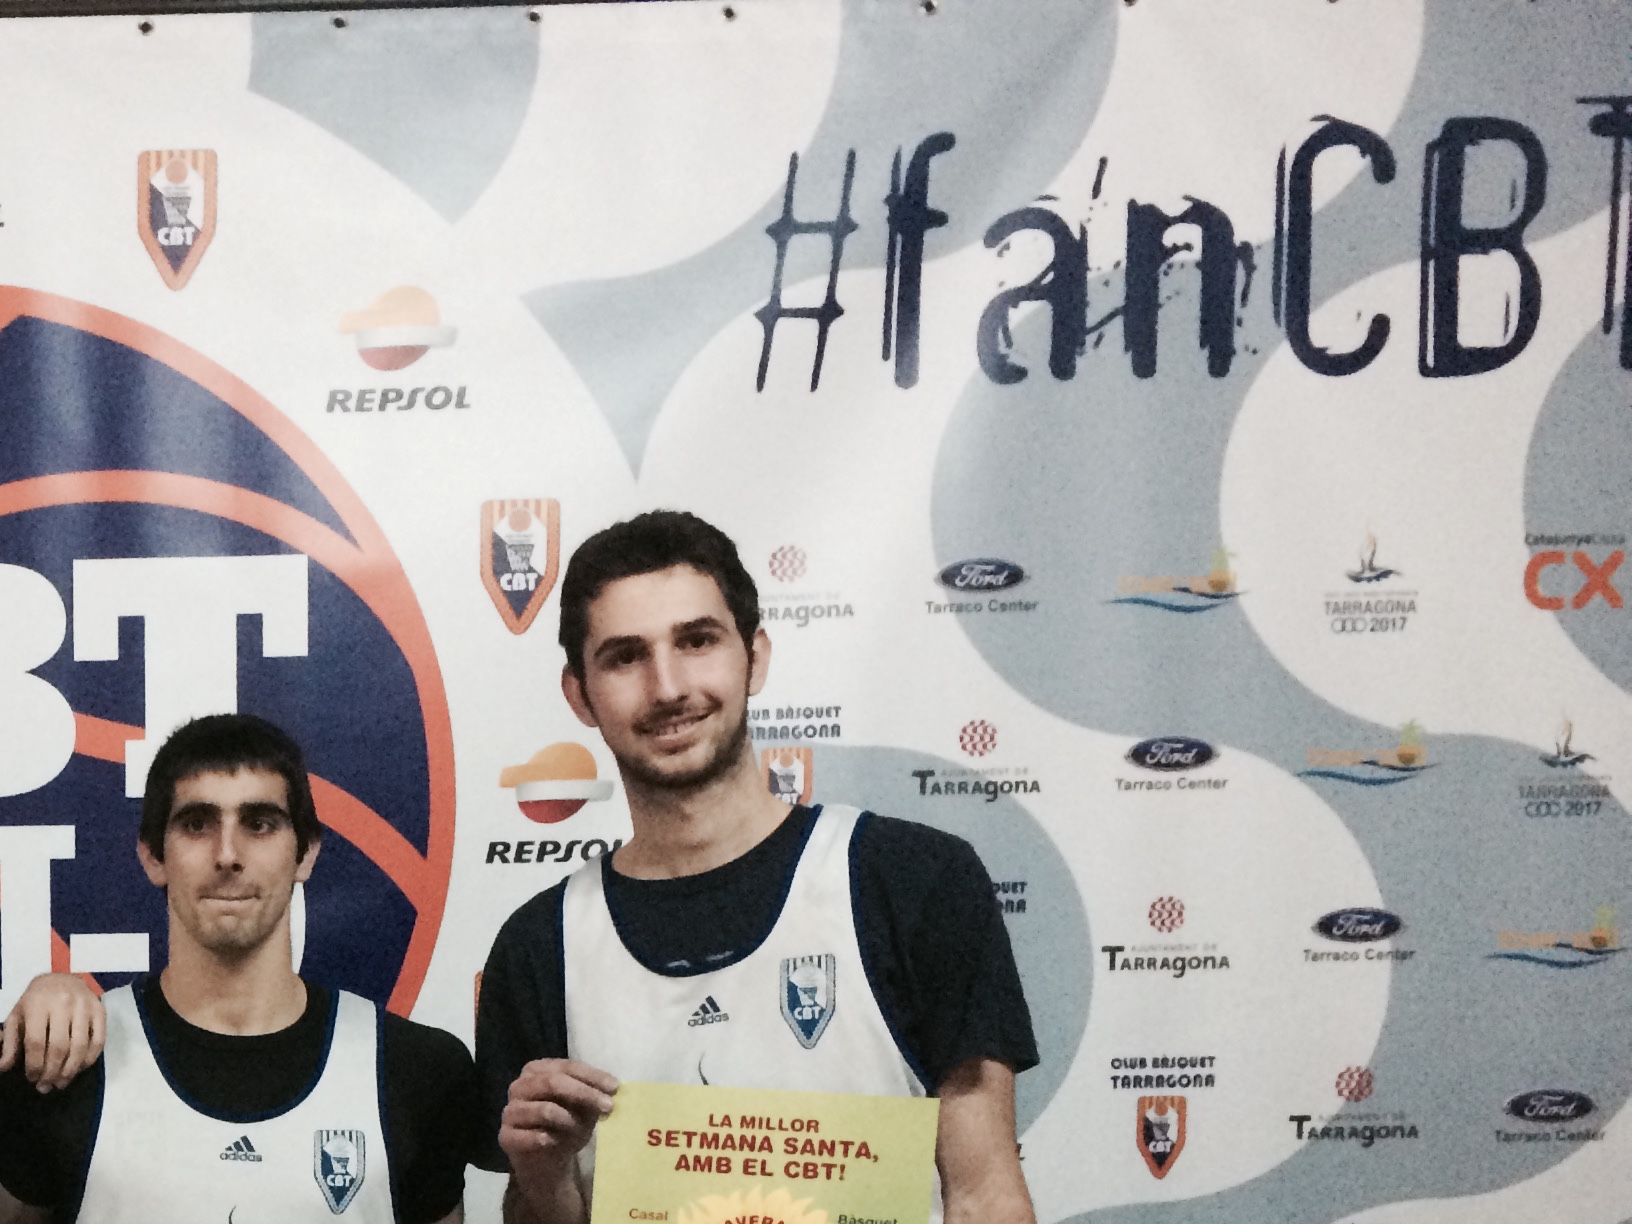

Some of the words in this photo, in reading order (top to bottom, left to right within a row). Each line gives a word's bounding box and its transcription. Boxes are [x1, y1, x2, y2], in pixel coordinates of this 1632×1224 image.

[157, 226, 196, 247] CBT
[326, 386, 471, 414] REPSOL
[500, 573, 538, 591] CBT
[1523, 551, 1625, 611] CX
[988, 599, 1038, 613] Center
[1324, 600, 1417, 615] TARRAGONA
[1369, 617, 1408, 633] 2017
[1177, 776, 1228, 791] Center
[688, 1011, 729, 1027] adidas
[794, 1006, 821, 1019] CBT
[1111, 1074, 1215, 1089] TARRAGONA
[708, 1113, 732, 1128] LA
[740, 1116, 820, 1133] MILLOR
[647, 1129, 773, 1154] SETMANA
[783, 1136, 879, 1163] SANTA,
[219, 1150, 263, 1163] adidas
[675, 1155, 732, 1173] AMB
[742, 1159, 774, 1177] EL
[784, 1162, 846, 1181] CBT!
[326, 1174, 354, 1187] CBT
[629, 1208, 668, 1221] Casal
